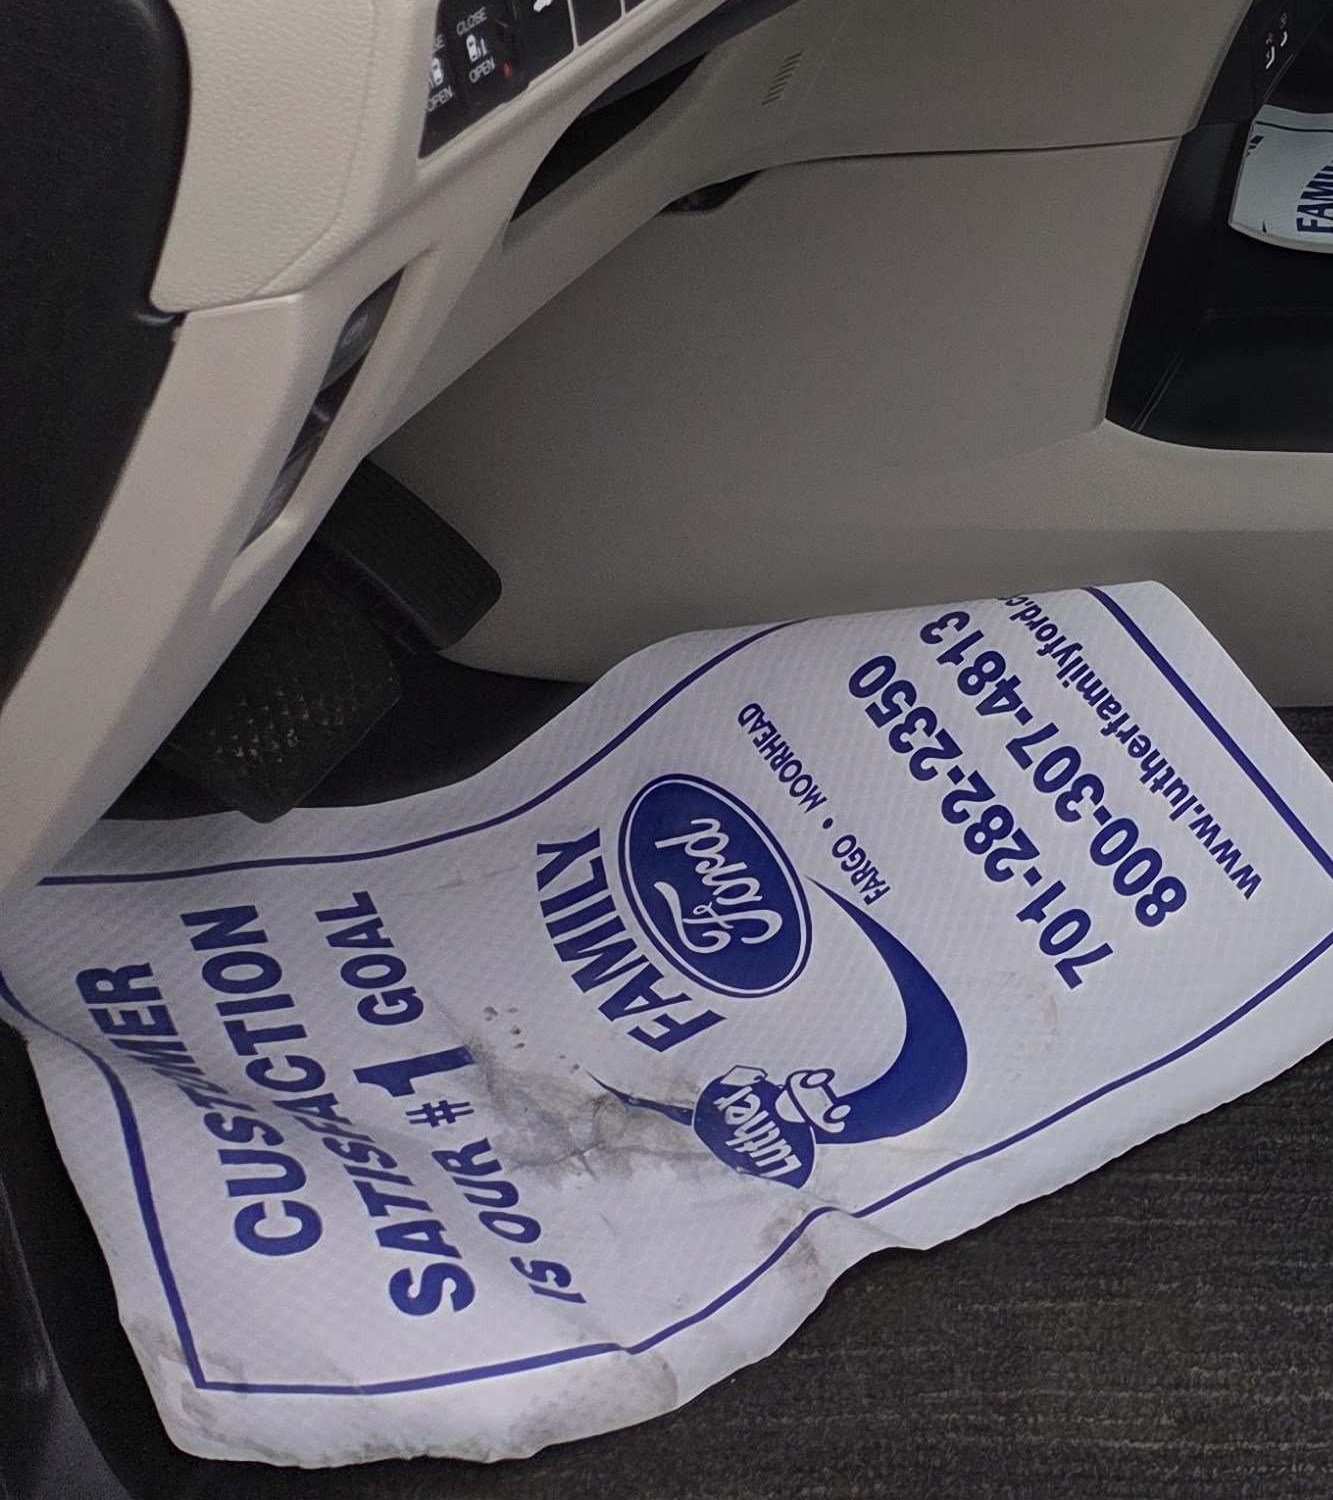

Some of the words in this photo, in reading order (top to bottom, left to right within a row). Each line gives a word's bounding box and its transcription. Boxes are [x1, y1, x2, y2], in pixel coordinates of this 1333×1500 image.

[456, 5, 488, 36] CLOSE
[469, 56, 496, 83] OPEN
[426, 85, 454, 112] OPEN
[737, 702, 828, 814] MOORHEAD
[919, 611, 1187, 927] 800-307-4813
[998, 594, 1262, 900] www.lutherfamilyford.c
[831, 834, 891, 905] FARGO
[848, 655, 1114, 989] 701-282-2350
[536, 827, 727, 1053] FAMILY
[654, 818, 783, 954] Ford
[315, 891, 424, 1026] GOAL
[180, 905, 476, 1316] SATISFACTION
[712, 1086, 802, 1179] Luther
[431, 1137, 541, 1244] OUR
[509, 1256, 587, 1304] IS
